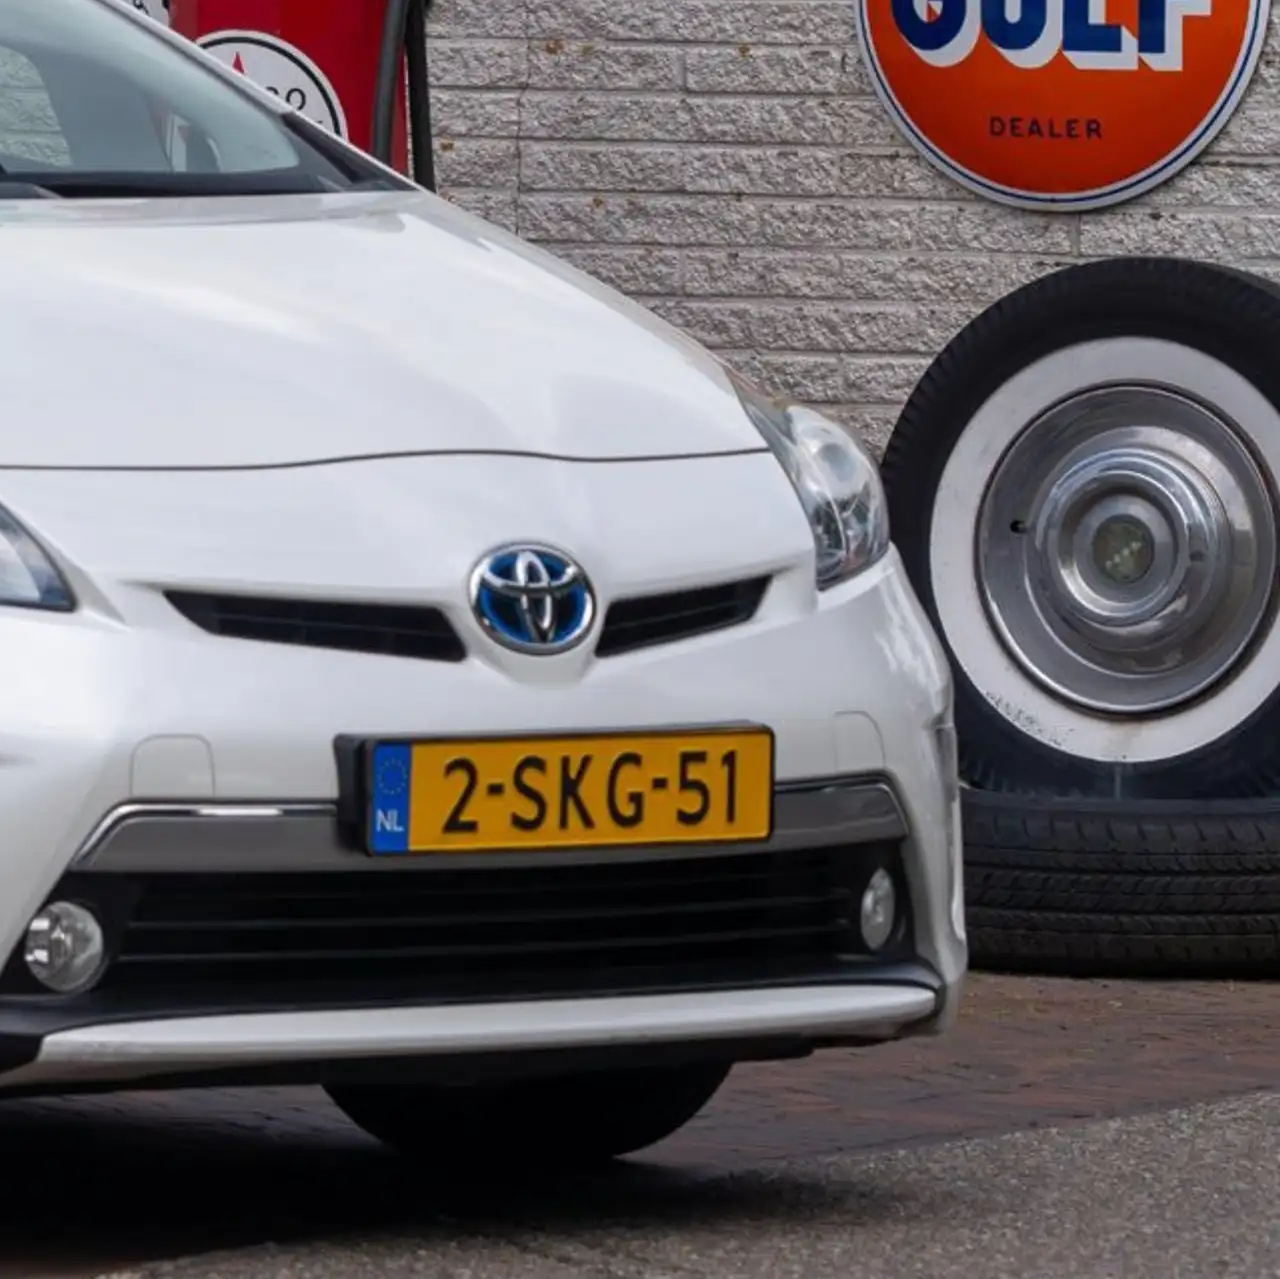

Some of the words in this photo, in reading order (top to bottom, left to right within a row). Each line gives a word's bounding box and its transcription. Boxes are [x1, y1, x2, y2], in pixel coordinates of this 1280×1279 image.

[989, 116, 1102, 139] DEALER
[442, 749, 738, 834] 2-SKG-51
[375, 809, 404, 832] NL
